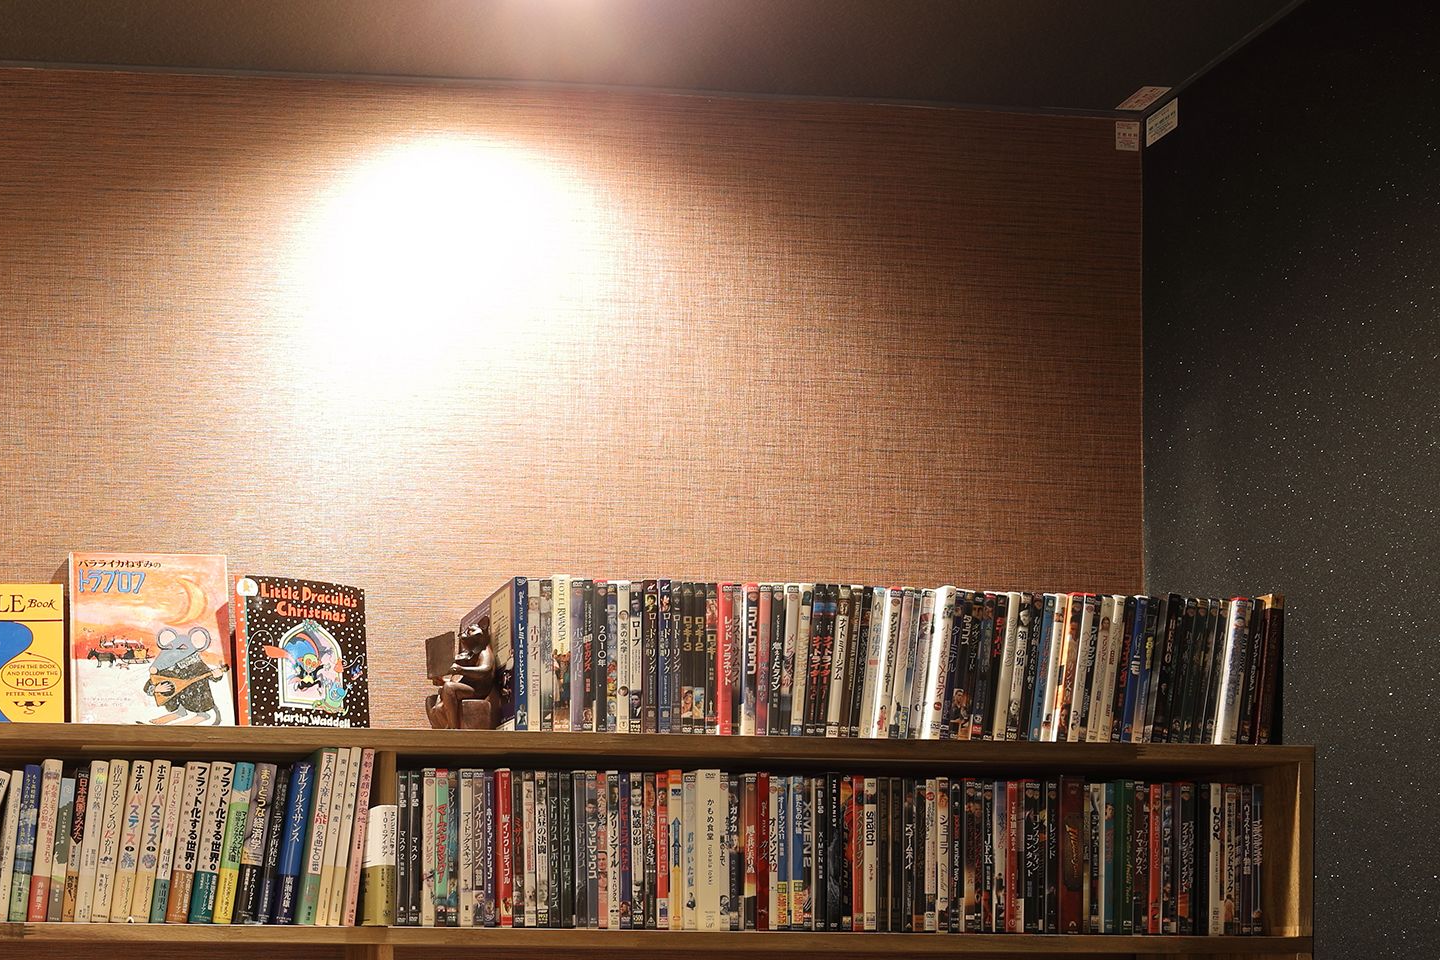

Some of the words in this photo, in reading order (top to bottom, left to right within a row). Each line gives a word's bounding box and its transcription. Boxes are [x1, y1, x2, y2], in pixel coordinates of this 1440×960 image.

[78, 559, 162, 568] バラライカねずみの
[78, 568, 147, 594] トラブロフ
[260, 582, 300, 600] Little
[302, 586, 358, 608] Dracula's
[26, 598, 60, 611] Book
[276, 601, 347, 623] Christmas
[558, 607, 567, 642] RWANDA
[1016, 630, 1028, 667] 第三の男
[15, 677, 49, 687] HOLE
[273, 711, 309, 724] Martin
[310, 714, 351, 728] Waddell
[184, 766, 208, 862] フラット化する世界
[209, 766, 233, 862] フラット化する世界
[250, 769, 272, 850] まっとうな経済学
[290, 764, 311, 843] ゴルフ・ルネサンス
[706, 798, 715, 842] かもめ食堂
[865, 810, 876, 847] snatch
[984, 833, 993, 865] JFK
